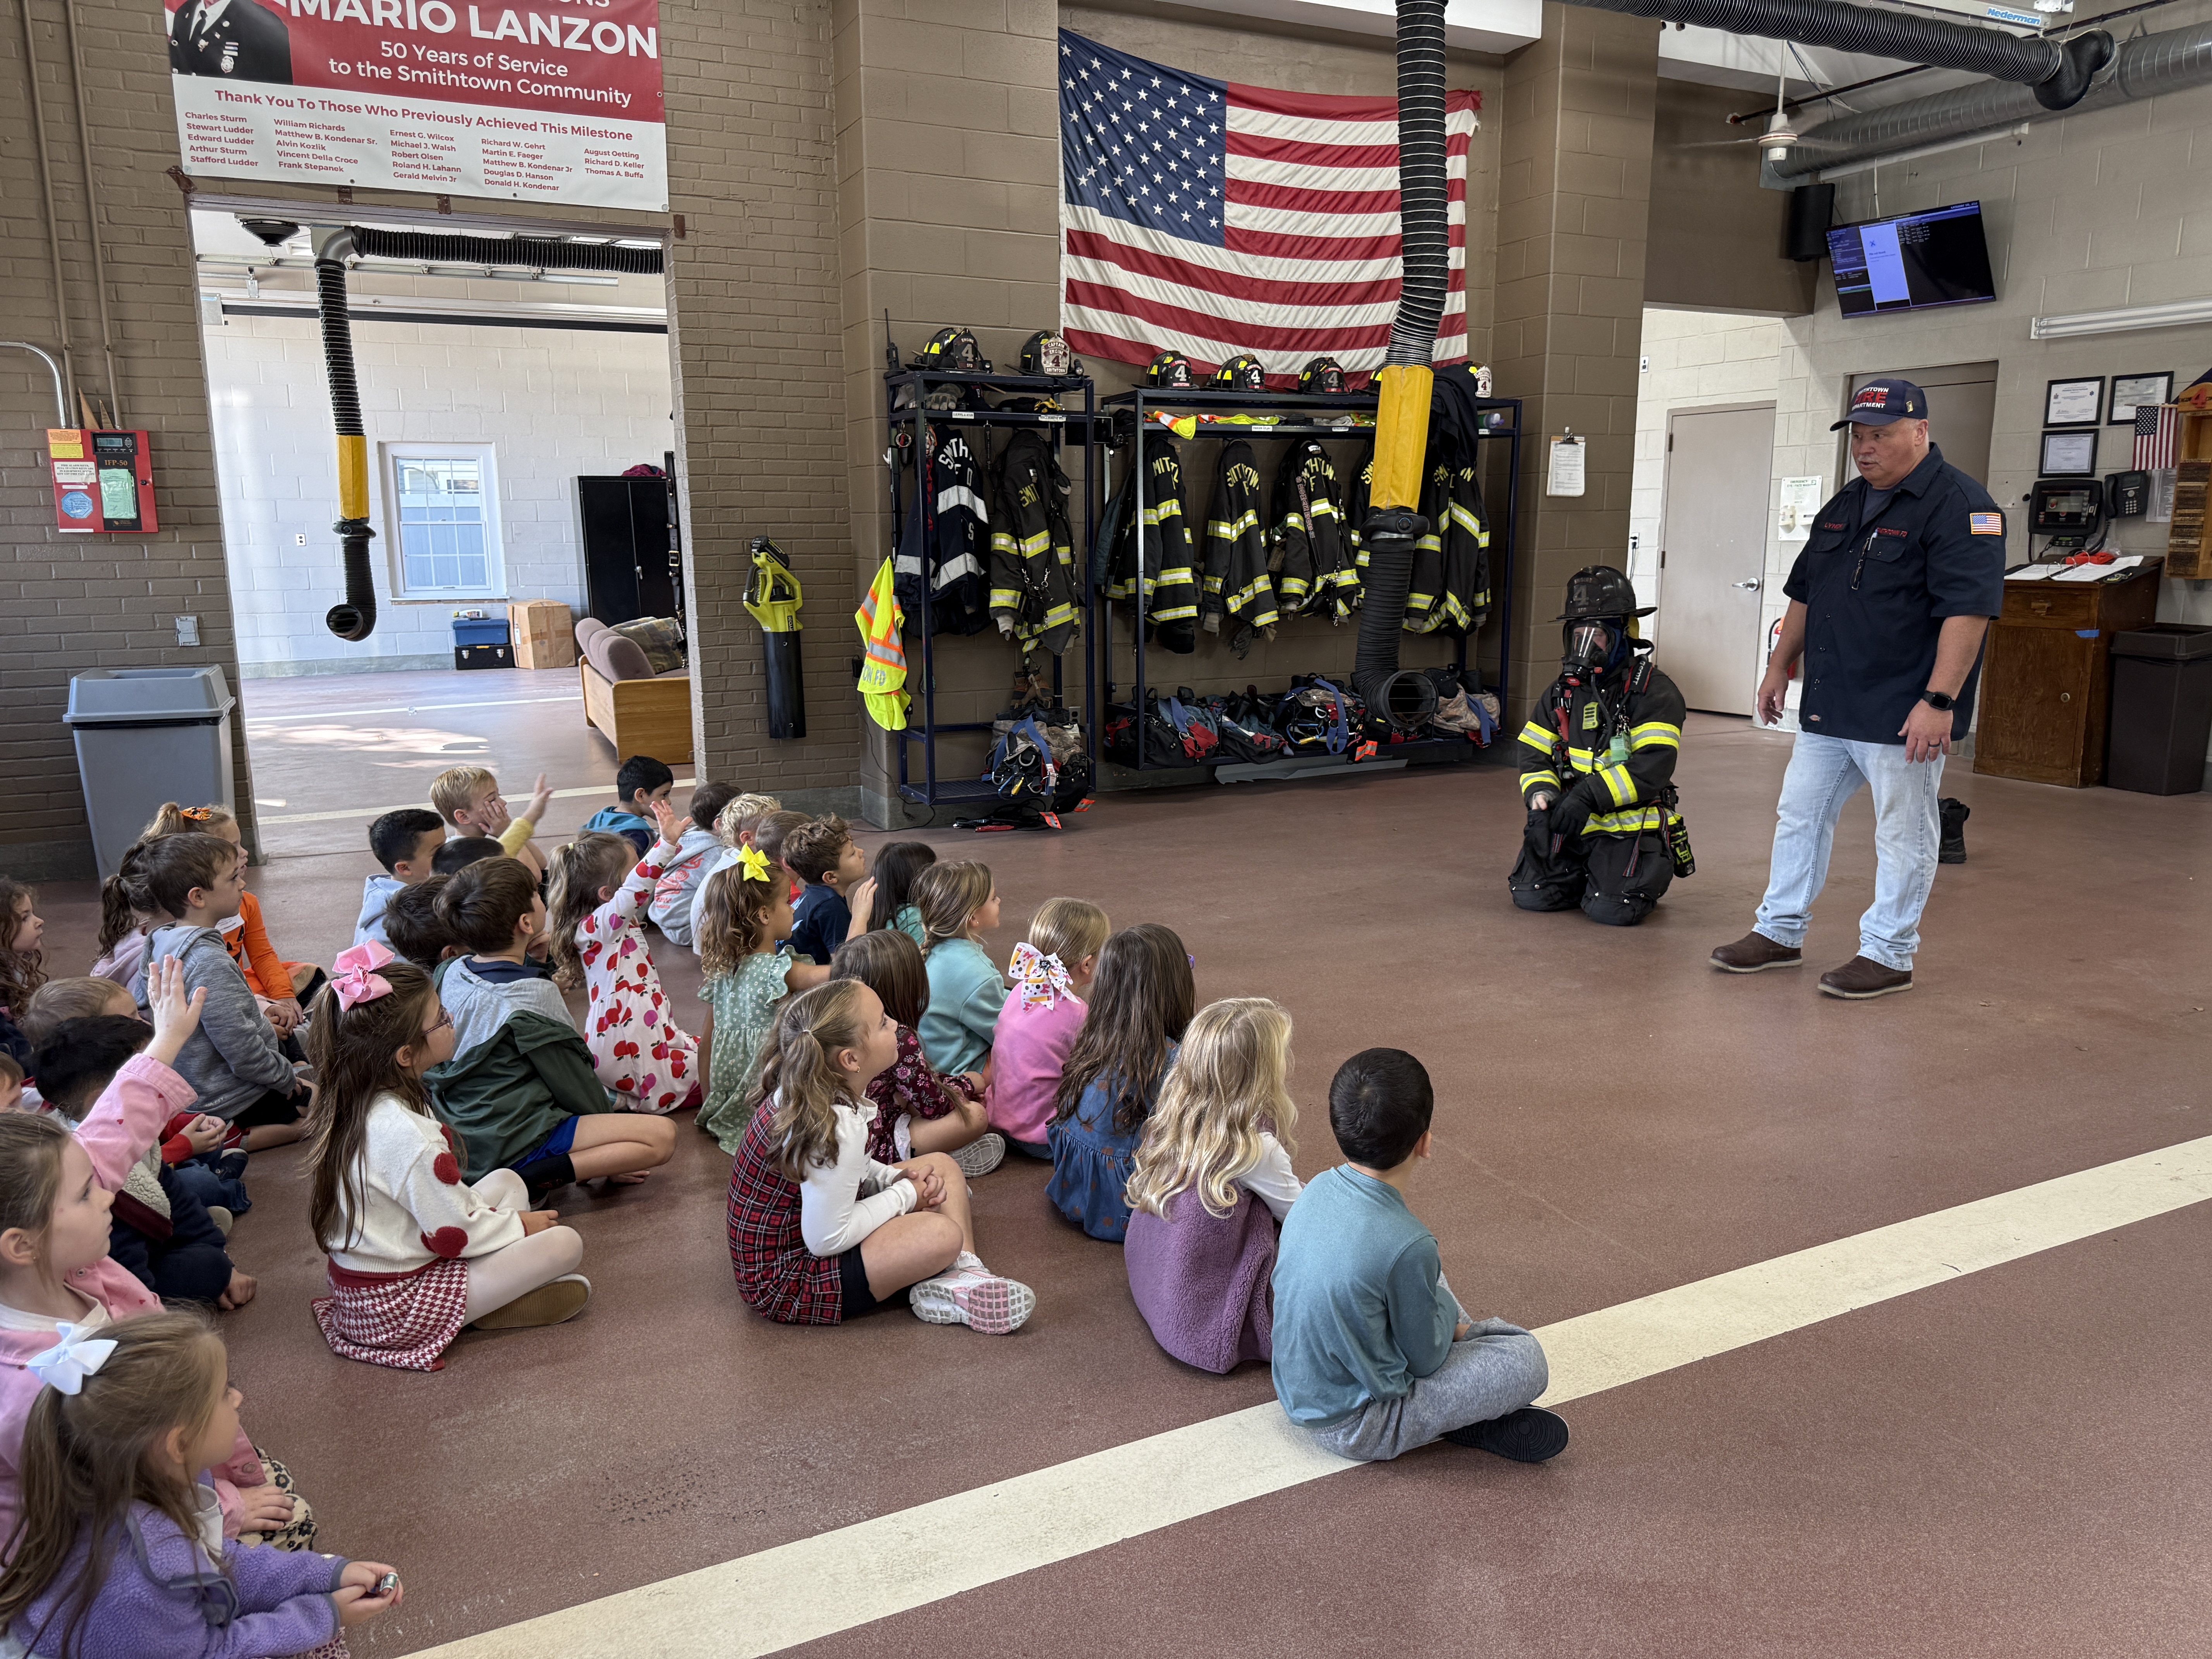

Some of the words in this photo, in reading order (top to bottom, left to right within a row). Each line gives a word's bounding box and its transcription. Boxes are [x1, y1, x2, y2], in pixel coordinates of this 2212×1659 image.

[1987, 9, 2040, 25] Nederman
[291, 0, 456, 33] MARIO
[469, 5, 657, 58] LANZON
[382, 41, 407, 58] 50
[412, 45, 468, 67] Years
[474, 53, 493, 68] of
[498, 55, 568, 76] Service
[329, 59, 350, 74] to
[357, 61, 392, 79] the
[398, 66, 511, 92] Smithtown
[517, 79, 631, 108] Community
[185, 112, 218, 120] Charles
[215, 90, 263, 105] Thank
[265, 95, 294, 108] You
[297, 98, 315, 109] To
[318, 100, 362, 113] Those
[364, 105, 398, 117] Who
[402, 108, 472, 127] Previously
[476, 117, 537, 131] Achieved
[540, 123, 568, 134] This
[571, 125, 632, 140] Milestone
[187, 123, 222, 132] Stewart
[274, 119, 307, 128] William
[309, 122, 345, 131] Richards
[188, 134, 222, 142] Edward
[275, 129, 313, 139] Matthew
[325, 134, 365, 143] Kondenar
[427, 133, 454, 141] Wilcox
[391, 140, 422, 148] Michael
[481, 139, 512, 147] Richard
[277, 150, 310, 159] Vincent
[392, 151, 419, 159] Robert
[228, 158, 258, 166] Ludder
[304, 163, 344, 172] Stepanek
[393, 161, 421, 169] Roland
[483, 158, 517, 167] Matthew
[528, 163, 564, 171] Kondenar
[484, 168, 514, 177] Douglas
[526, 172, 553, 180] Hanson
[523, 182, 559, 191] Kondenar
[962, 344, 974, 362] 4
[1051, 356, 1060, 367] 4
[1175, 365, 1187, 381] 4
[1251, 370, 1260, 383] 4
[1328, 372, 1338, 387] 4
[1481, 381, 1487, 391] 4
[2190, 388, 2207, 409] 4
[1573, 585, 1589, 606] 4
[874, 670, 886, 686] FD
